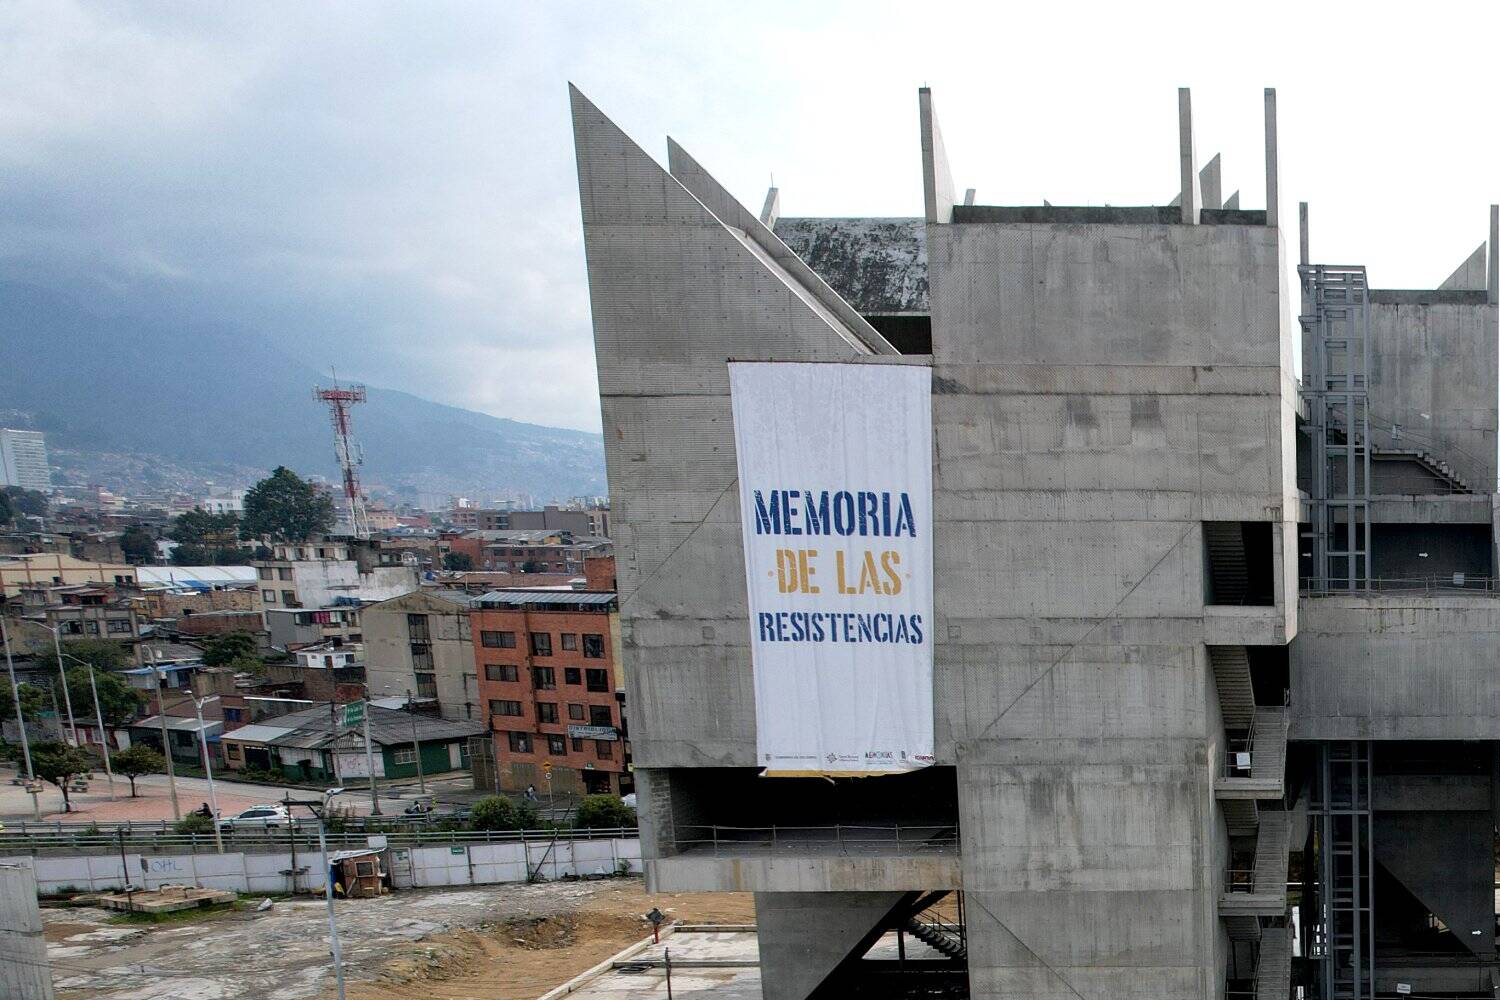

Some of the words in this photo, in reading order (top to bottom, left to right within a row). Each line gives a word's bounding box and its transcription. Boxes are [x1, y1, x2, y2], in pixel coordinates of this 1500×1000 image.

[754, 490, 917, 538] MEMORIA
[775, 549, 820, 594] DE
[836, 550, 902, 595] LAS
[759, 612, 924, 644] RESISTENCIAS
